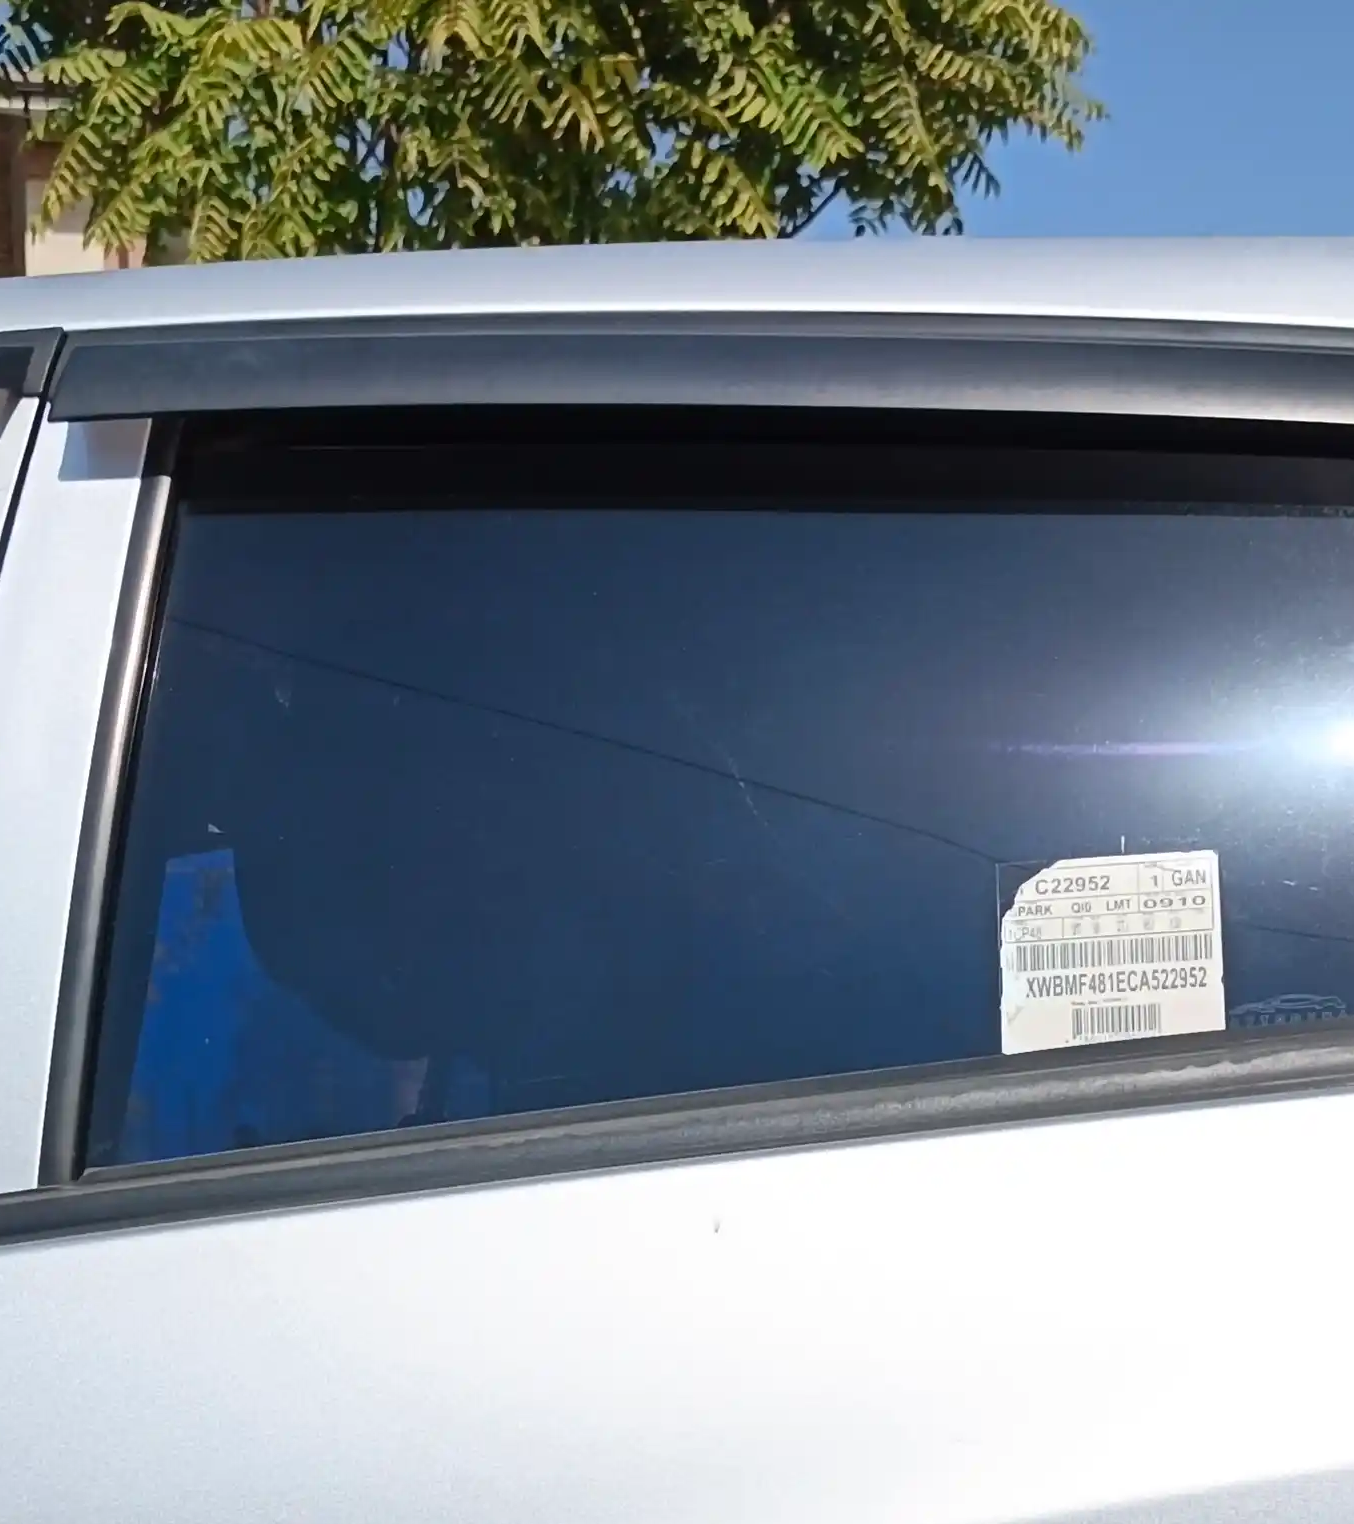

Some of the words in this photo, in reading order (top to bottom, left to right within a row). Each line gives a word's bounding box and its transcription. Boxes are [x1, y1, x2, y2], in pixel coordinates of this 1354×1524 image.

[1034, 874, 1111, 896] C22952
[1149, 874, 1159, 888] 1
[1171, 869, 1207, 887] GAN
[1105, 898, 1132, 912] LMT
[1143, 894, 1207, 910] 0910
[1025, 966, 1208, 998] XWBMF481ECA522952
